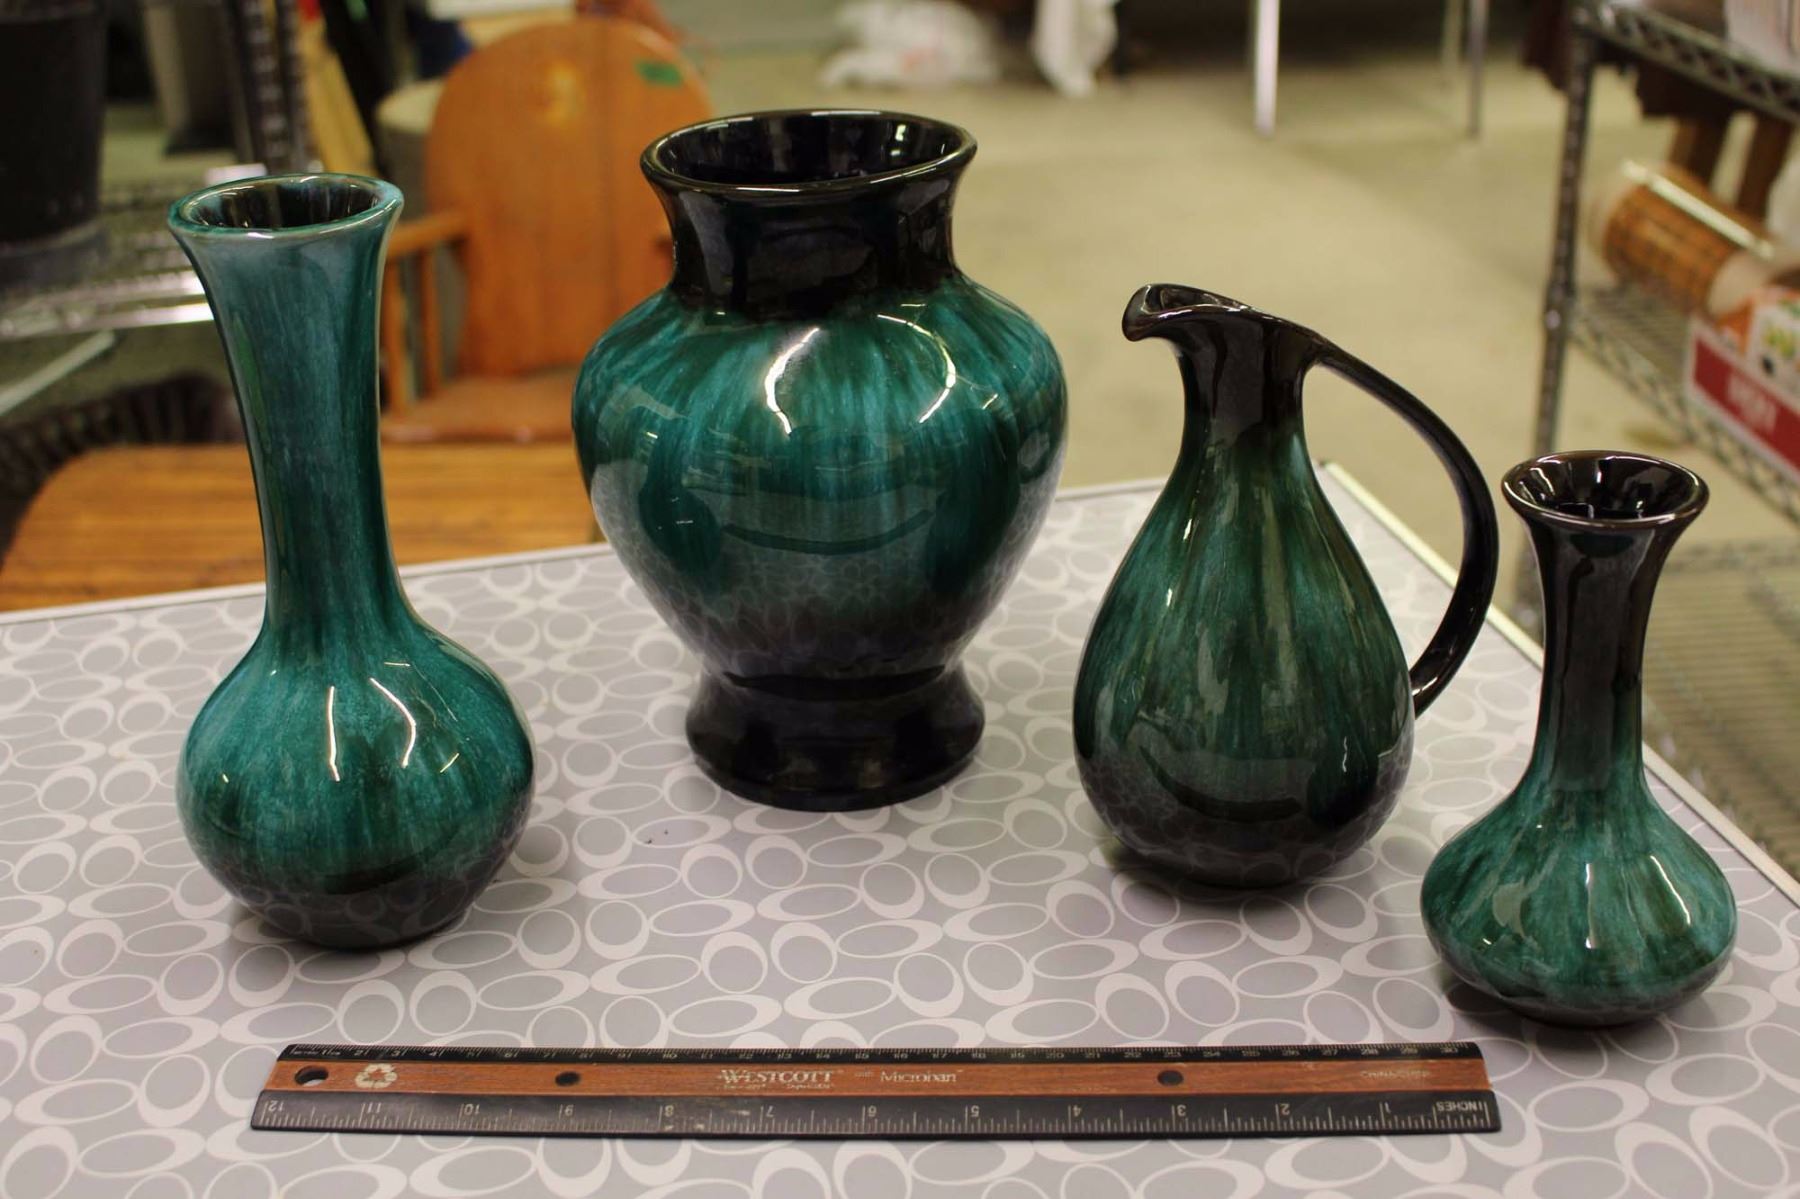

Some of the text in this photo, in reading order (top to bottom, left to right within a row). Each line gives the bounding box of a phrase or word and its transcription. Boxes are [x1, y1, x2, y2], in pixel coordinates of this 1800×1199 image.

[719, 1069, 834, 1083] WESTCOTT
[268, 1100, 1483, 1118] INCHES 1 2 3 4 5 6 7 8 9 10 11 12
